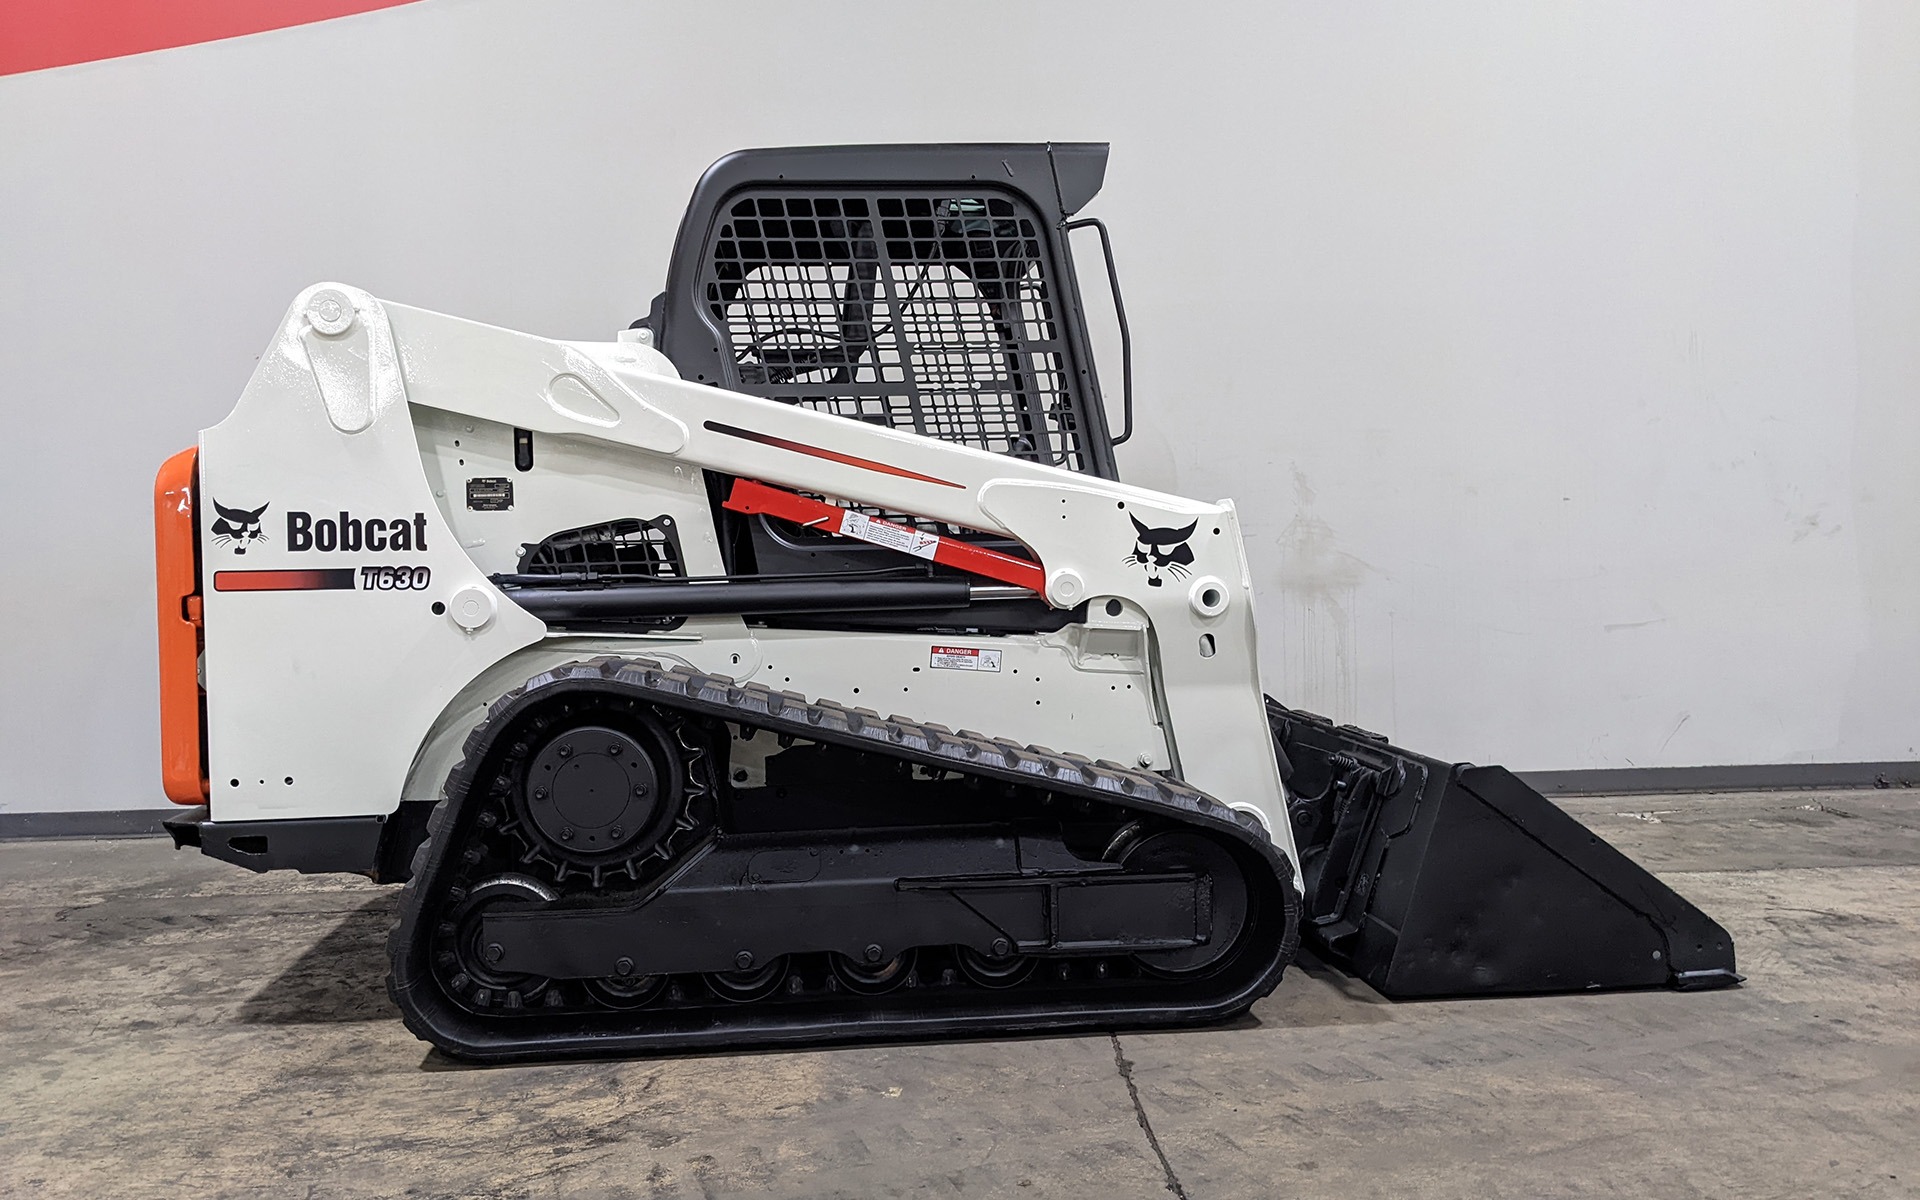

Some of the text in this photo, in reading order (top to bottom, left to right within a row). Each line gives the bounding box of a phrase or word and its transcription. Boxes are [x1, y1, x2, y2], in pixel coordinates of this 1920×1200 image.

[287, 511, 428, 551] Bobcat
[882, 520, 907, 531] DANGER
[361, 566, 431, 590] T630
